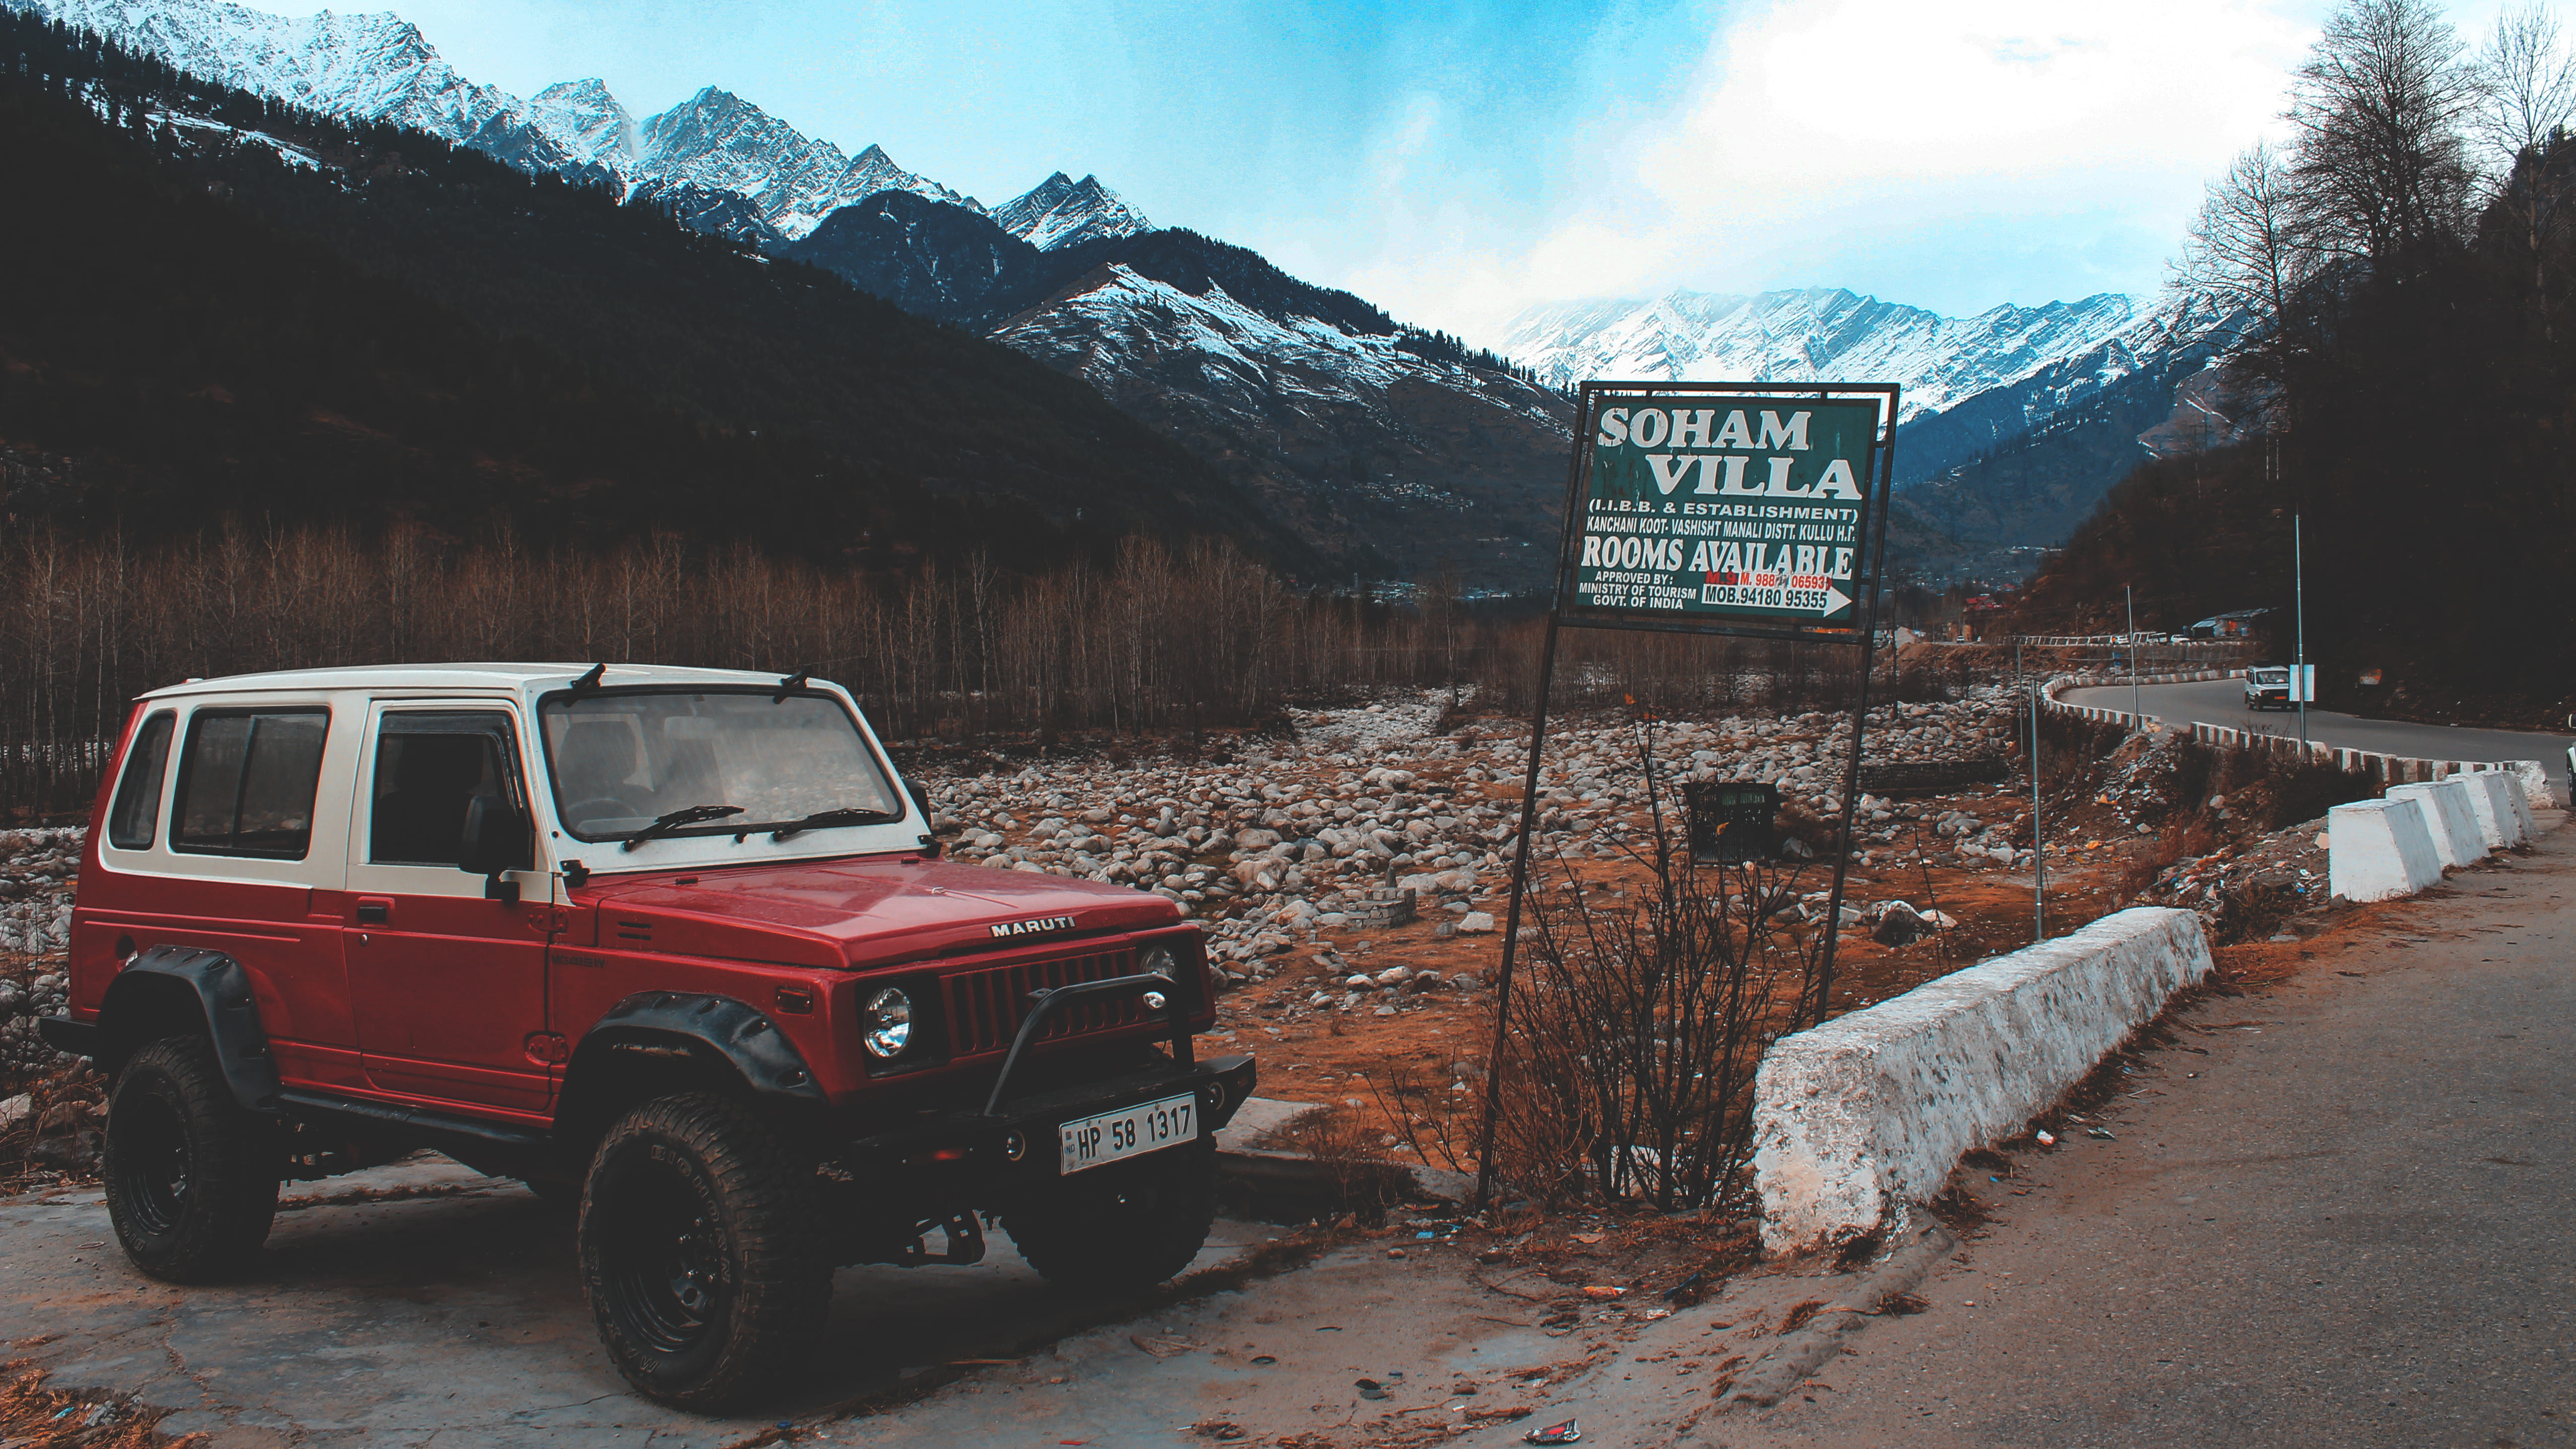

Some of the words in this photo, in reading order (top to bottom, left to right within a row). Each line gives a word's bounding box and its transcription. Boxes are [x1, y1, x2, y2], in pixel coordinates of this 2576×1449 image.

[1597, 408, 1811, 449] SOHAM
[1645, 454, 1862, 500] VILLA
[1663, 502, 1676, 513] &
[1684, 503, 1858, 524] ESTABLISHMENT)
[1586, 516, 1637, 533] KANCHANI
[1672, 519, 1721, 537] VASHISHT
[1723, 521, 1763, 539] MANALI
[1765, 522, 1795, 540] DISTT.
[1799, 524, 1834, 541] KULLU
[1581, 536, 1684, 571] ROOMS
[1689, 541, 1854, 580] AVAILABLE
[1595, 571, 1650, 584] APPROVED
[1579, 582, 1629, 595] MINISTRY
[1631, 585, 1645, 596] OF
[1648, 585, 1697, 600] TOURISM
[1785, 590, 1828, 608] 95355
[1593, 595, 1627, 607] GOVT.
[1631, 597, 1646, 608] OF
[1650, 597, 1684, 610] INDIA
[991, 916, 1076, 937] MARUTI
[1064, 1144, 1076, 1154] IND
[1077, 1127, 1101, 1160] HP
[1112, 1118, 1136, 1150] 58
[1147, 1104, 1191, 1142] 1317
